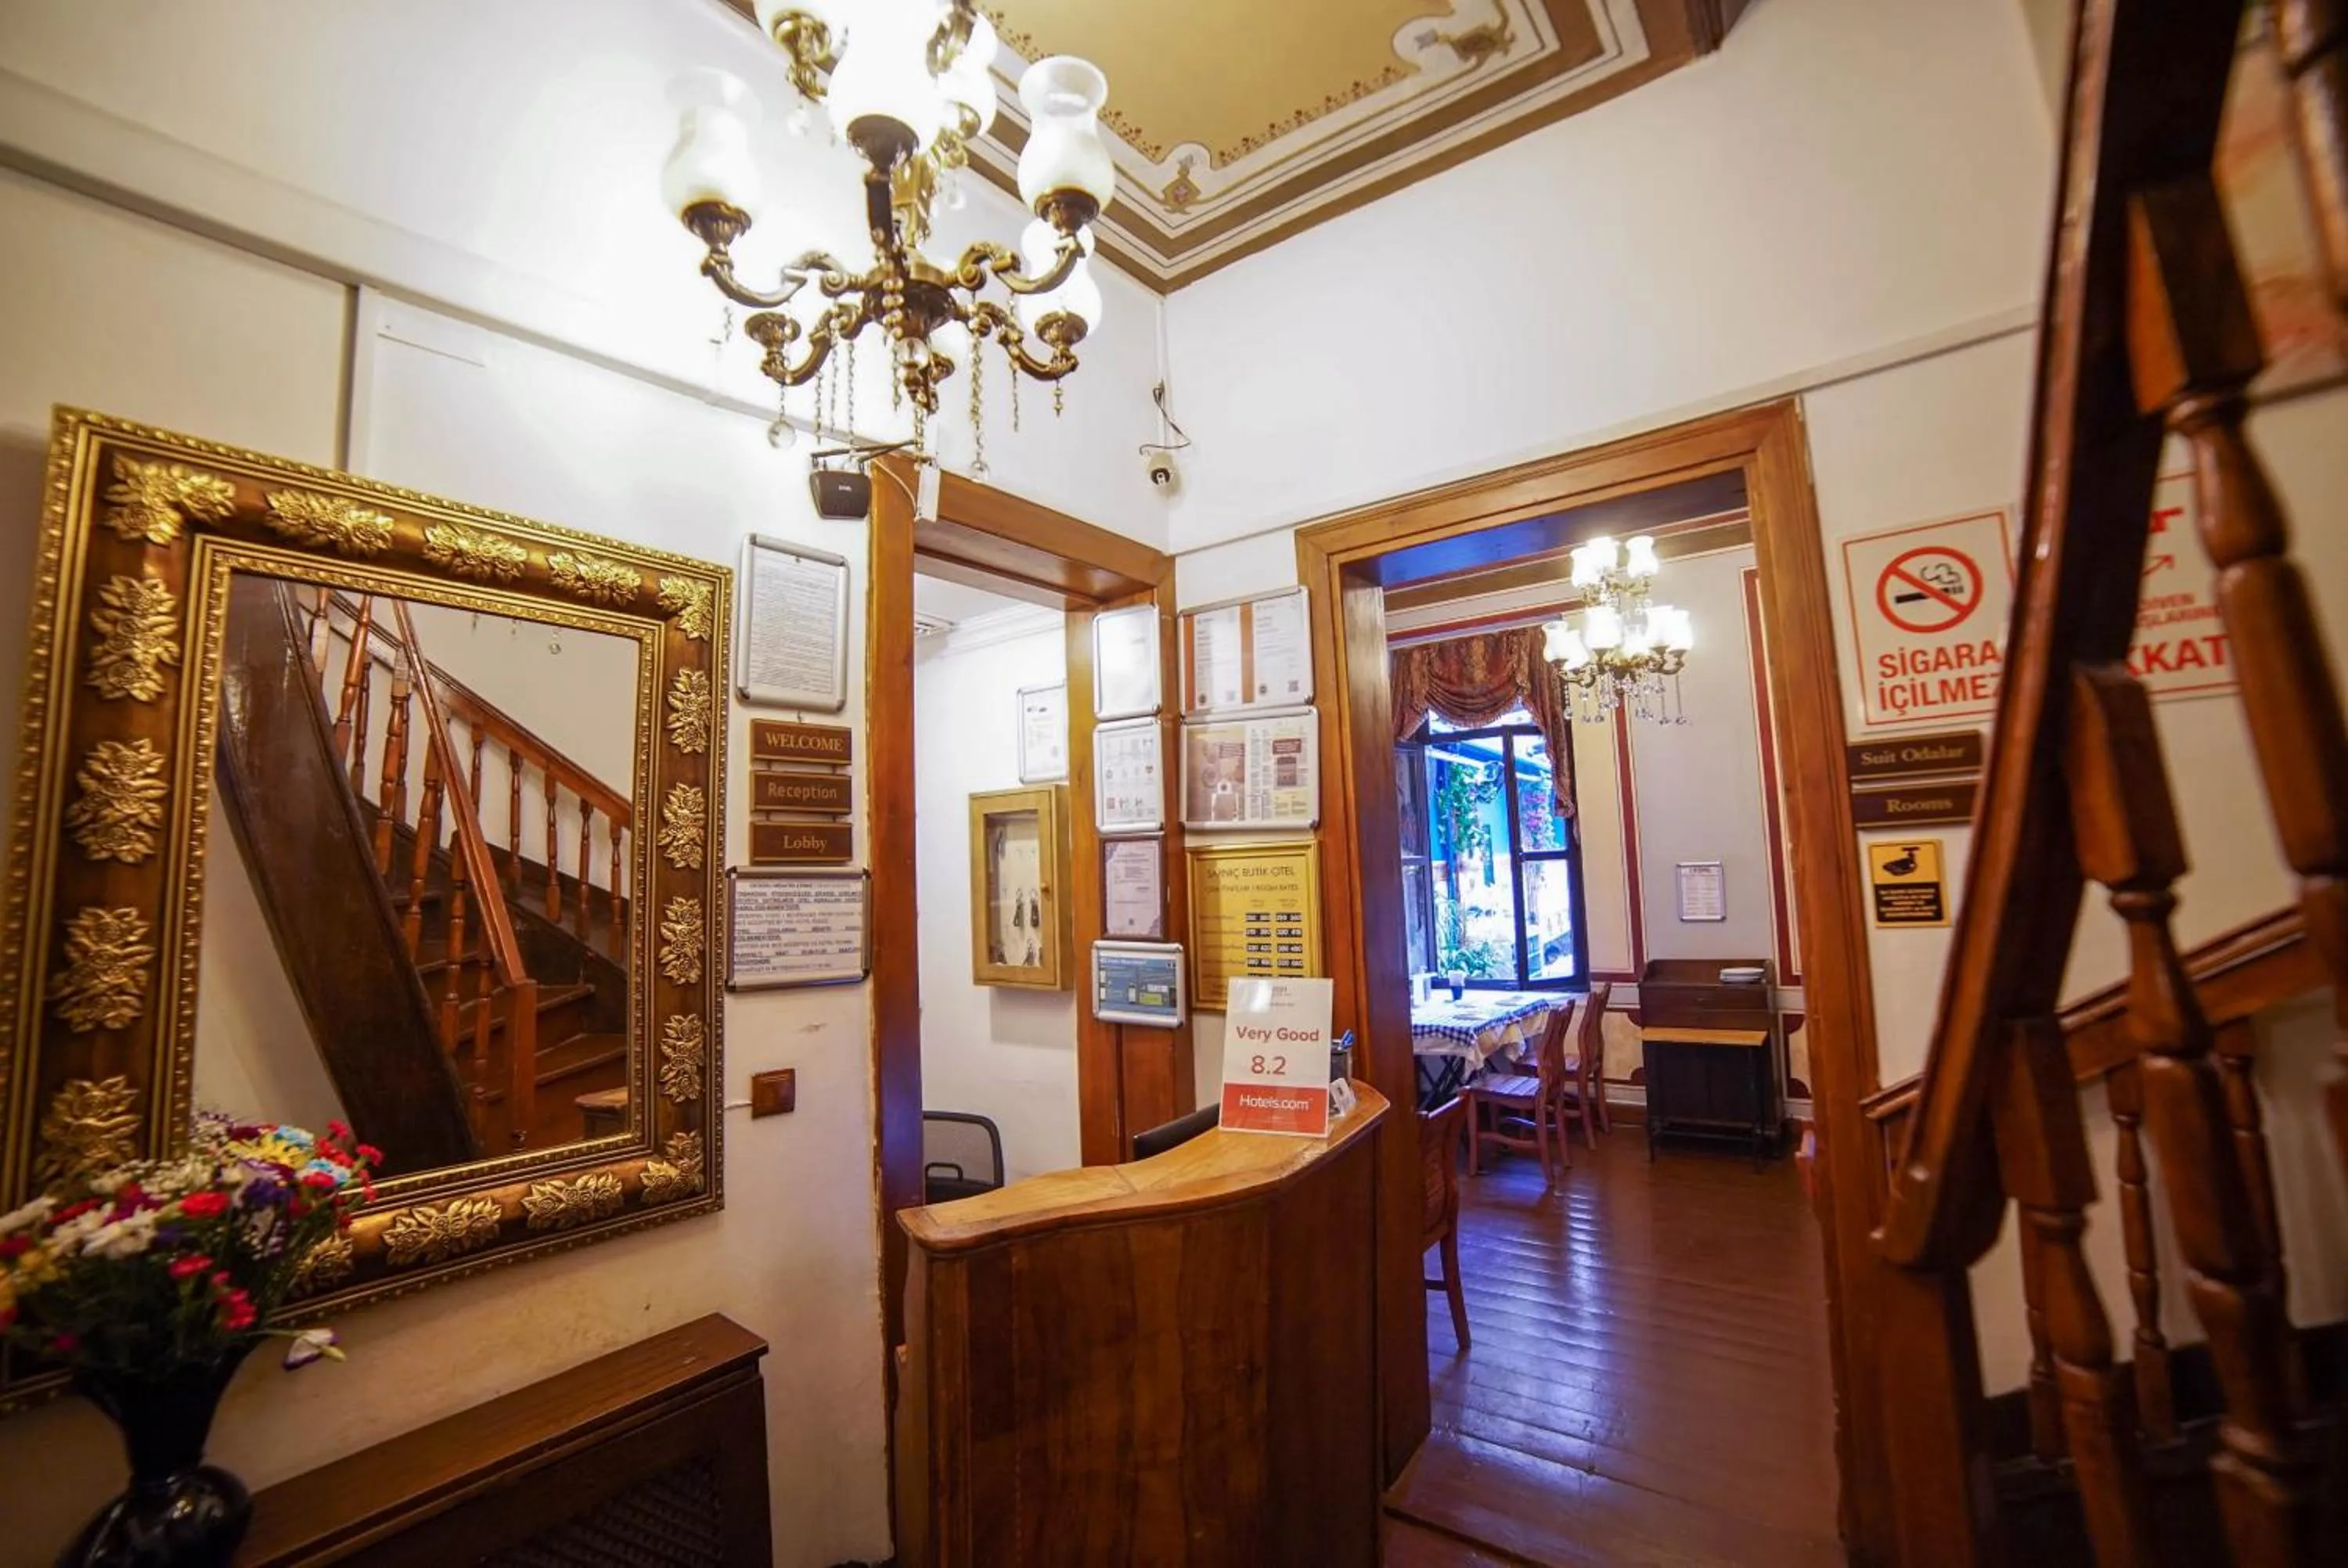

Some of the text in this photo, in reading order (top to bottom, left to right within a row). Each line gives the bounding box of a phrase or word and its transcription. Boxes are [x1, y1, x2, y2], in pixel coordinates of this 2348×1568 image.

[1878, 639, 2002, 679] SİGARA
[2126, 633, 2230, 678] KKAT
[765, 732, 843, 752] WELCOME
[1901, 745, 1964, 762] Odalar
[768, 782, 837, 800] Reception
[1885, 797, 1953, 813] Rooms
[783, 835, 827, 852] Lobby
[1236, 1026, 1320, 1044] Very Good
[1251, 1055, 1286, 1076] 8.2
[1240, 1094, 1309, 1111] Hotels.com
